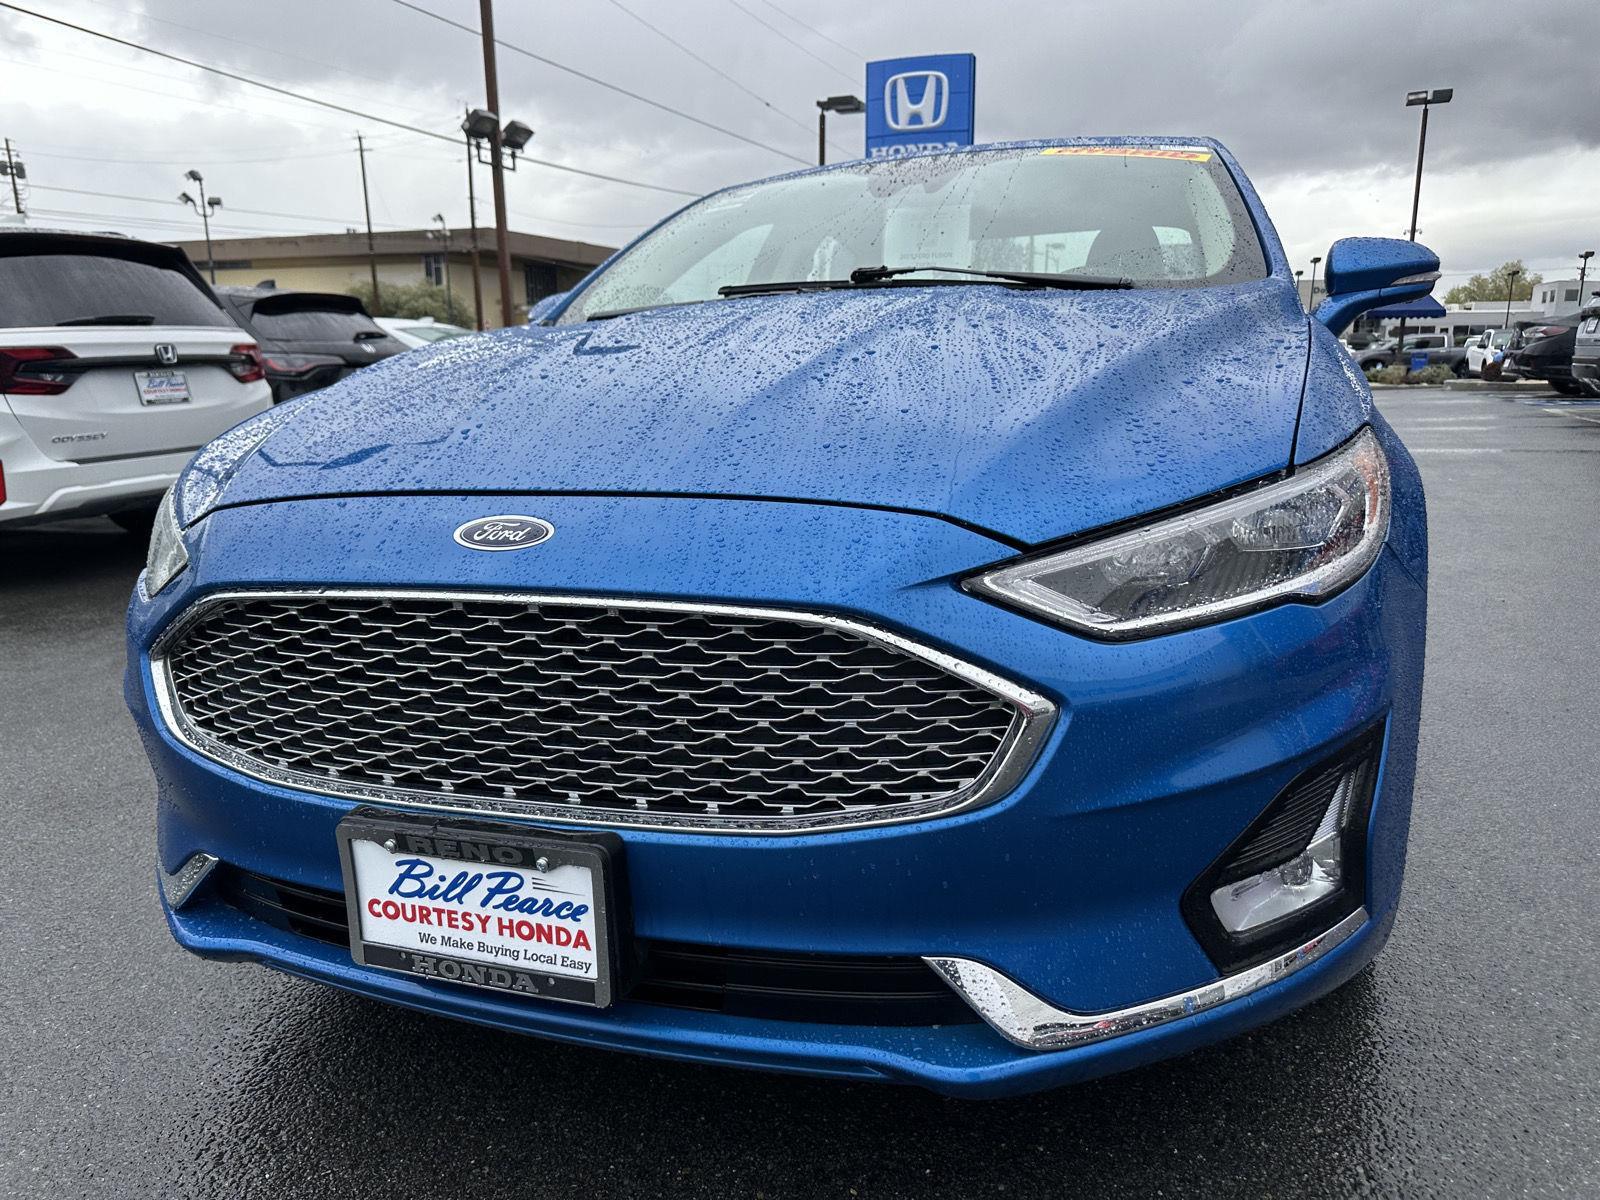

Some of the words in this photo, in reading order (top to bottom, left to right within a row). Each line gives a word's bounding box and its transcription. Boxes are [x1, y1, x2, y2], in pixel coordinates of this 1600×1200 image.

[51, 431, 107, 444] ODYSSEY
[473, 521, 531, 541] Ford
[405, 835, 523, 864] RENO
[388, 858, 483, 905] Bill
[479, 871, 589, 922] Pearce
[367, 898, 491, 934] COURTESY
[497, 917, 592, 951] HONDA
[418, 932, 437, 945] We
[440, 936, 474, 950] Make
[477, 941, 520, 960] Buying
[523, 949, 557, 965] Local
[560, 956, 592, 973] Easy
[412, 954, 539, 993] HONDA
